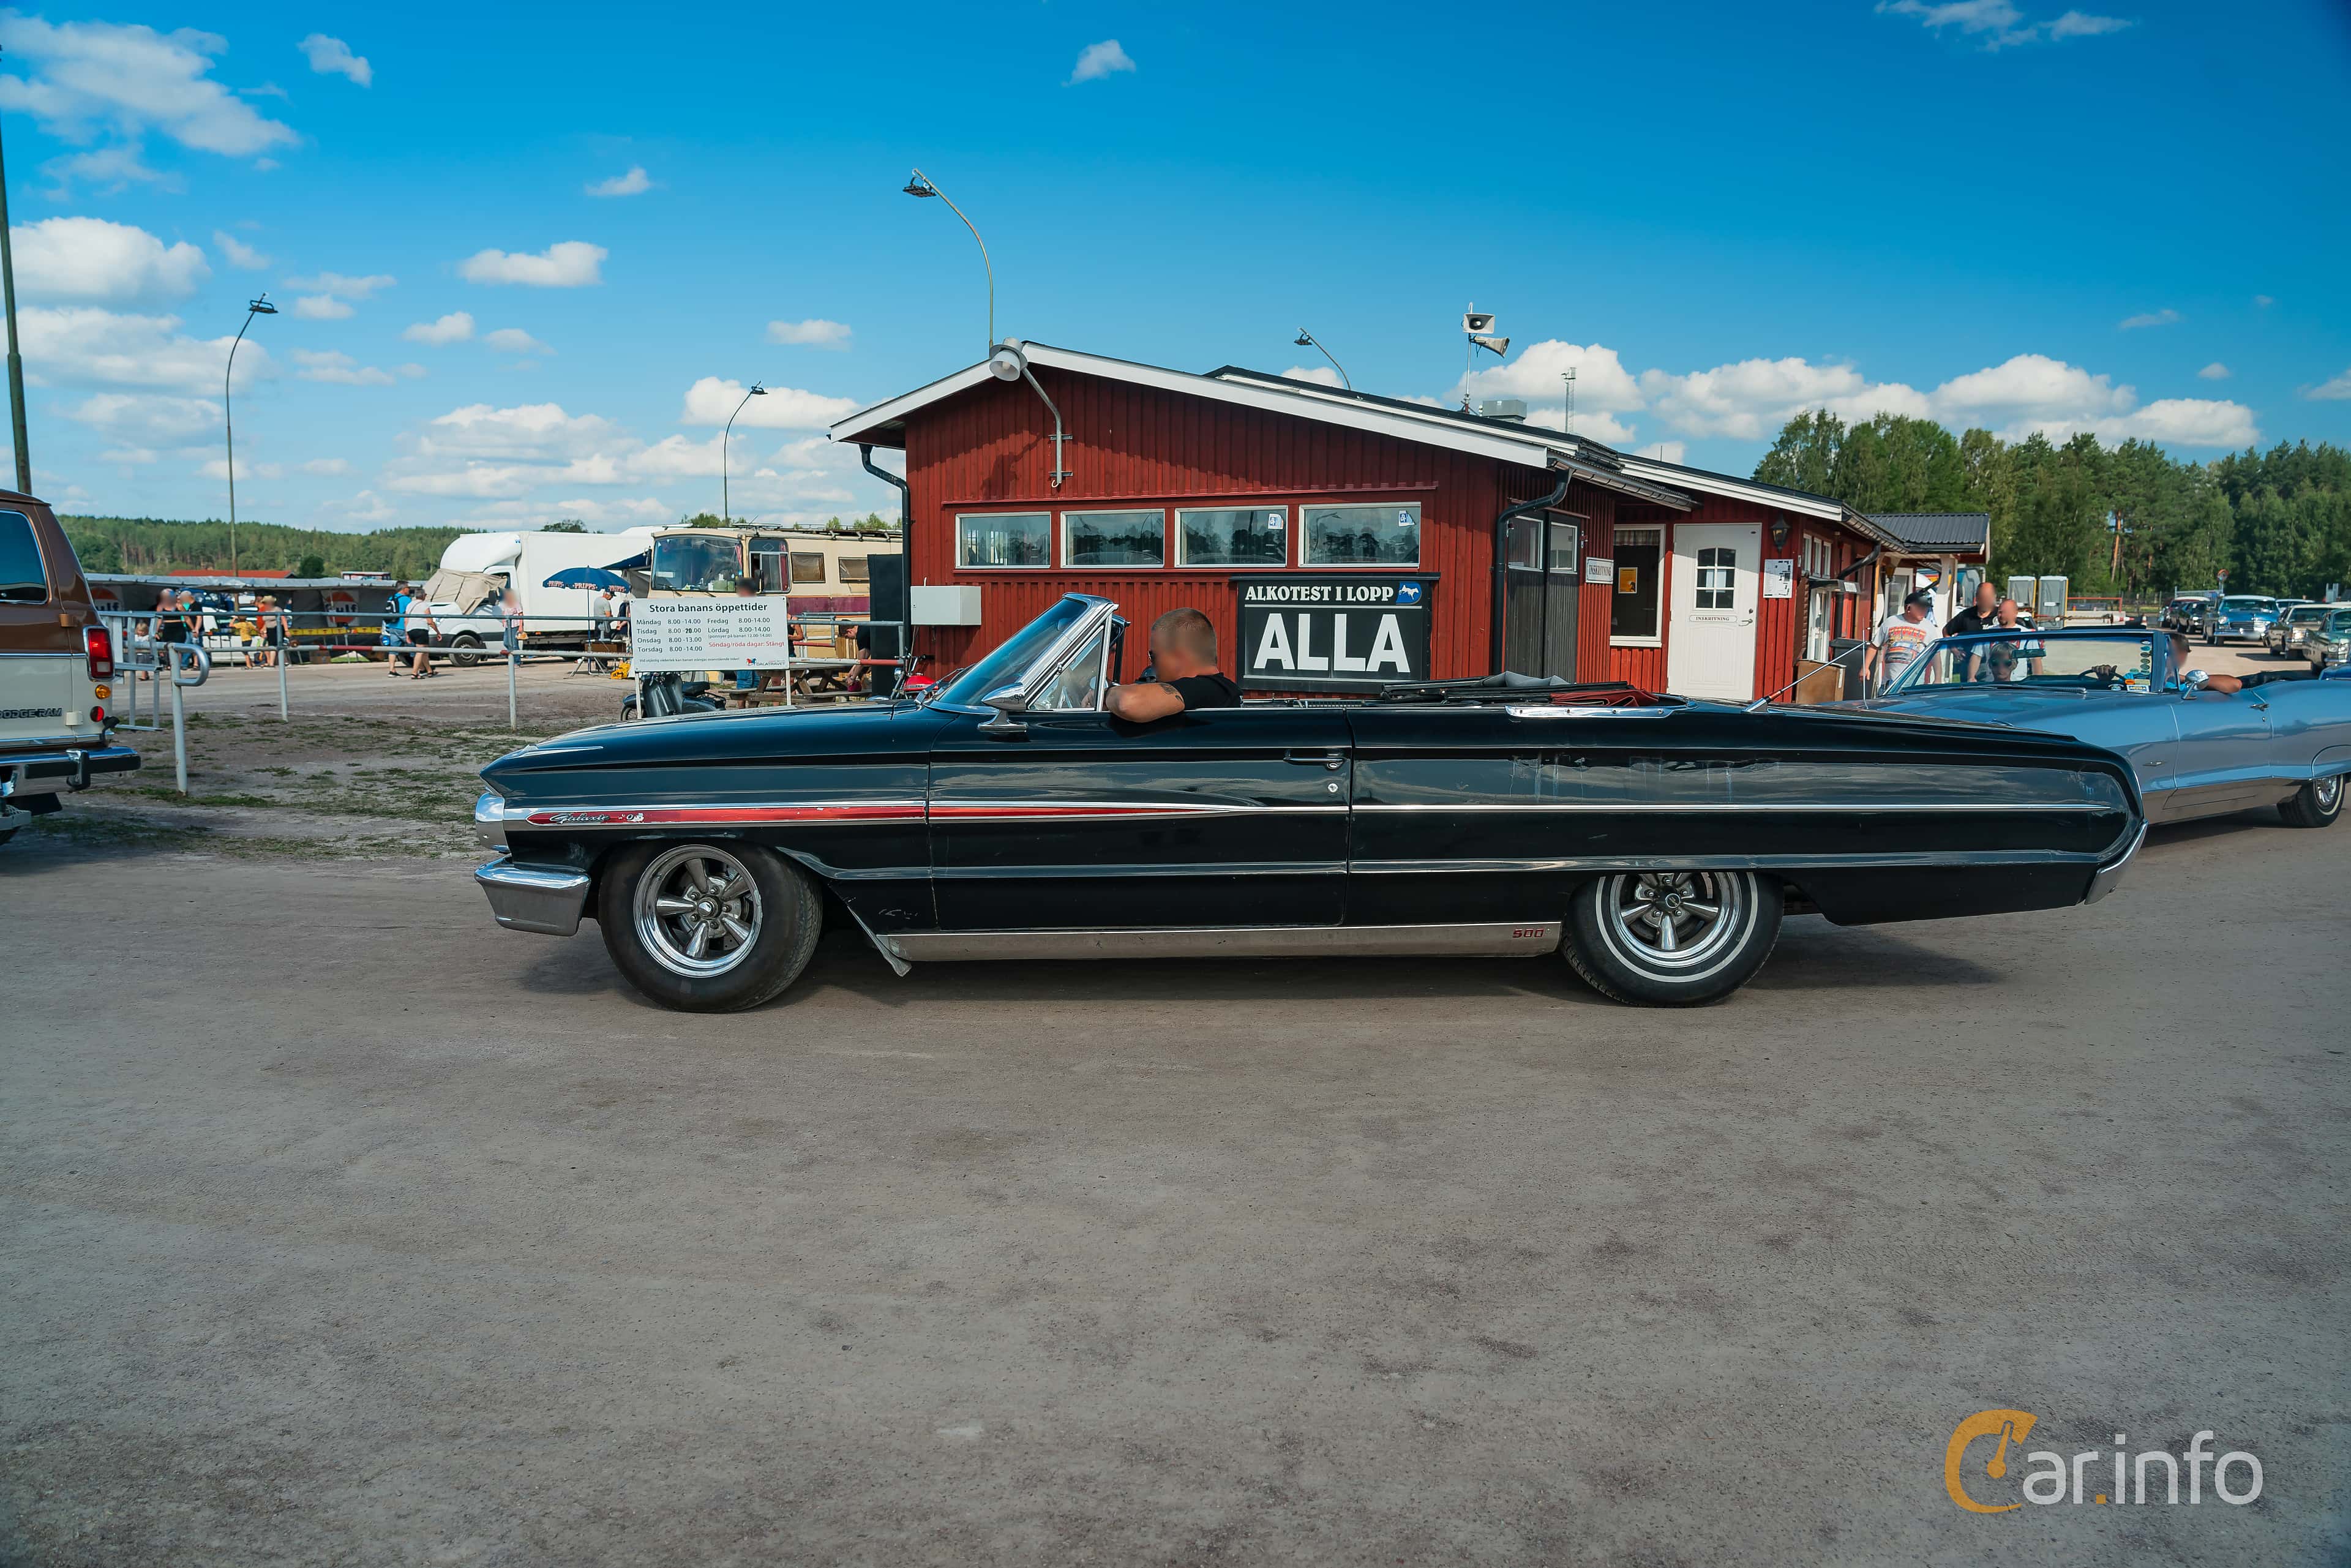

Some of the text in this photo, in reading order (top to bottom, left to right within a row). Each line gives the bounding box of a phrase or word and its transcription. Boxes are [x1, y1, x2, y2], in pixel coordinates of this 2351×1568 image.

[1245, 585, 1394, 602] ALKOTEST I LOPP
[678, 604, 713, 612] banans
[715, 602, 767, 613] öppettider
[1254, 613, 1411, 673] ALLA
[38, 707, 62, 718] RAM
[549, 812, 610, 824] Galaxie
[1512, 928, 1544, 938] 500
